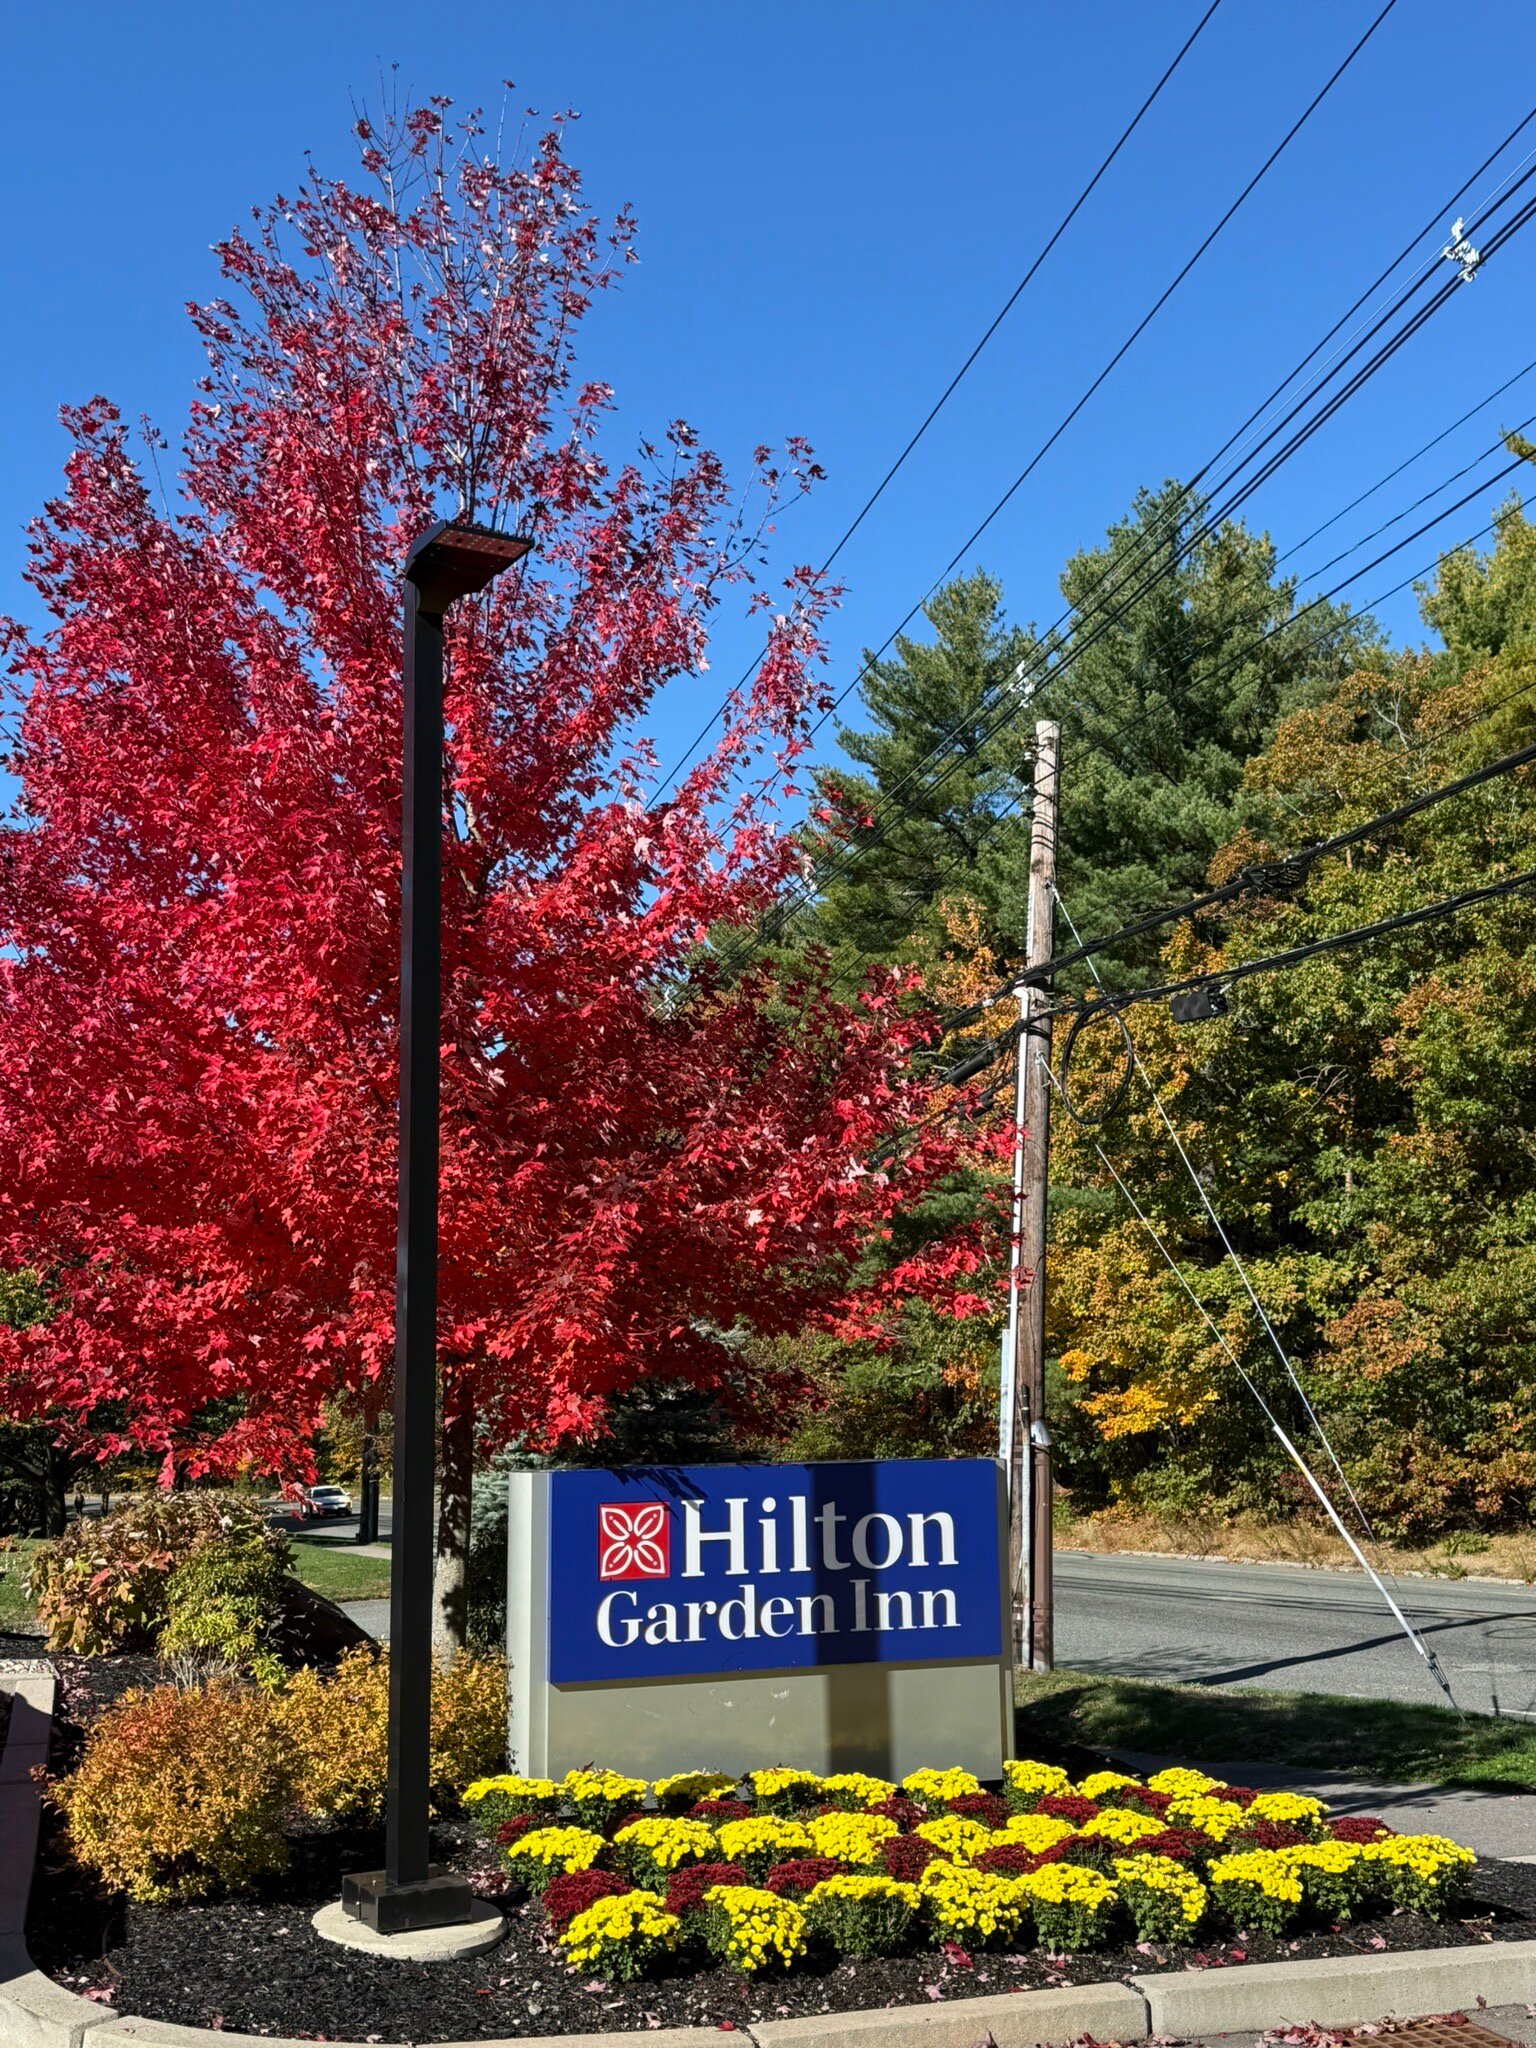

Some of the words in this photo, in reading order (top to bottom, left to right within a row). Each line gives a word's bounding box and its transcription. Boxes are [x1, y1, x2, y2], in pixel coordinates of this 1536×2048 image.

[681, 1495, 959, 1578] Hilton
[596, 1584, 840, 1648] Garden
[849, 1579, 962, 1632] Inn
